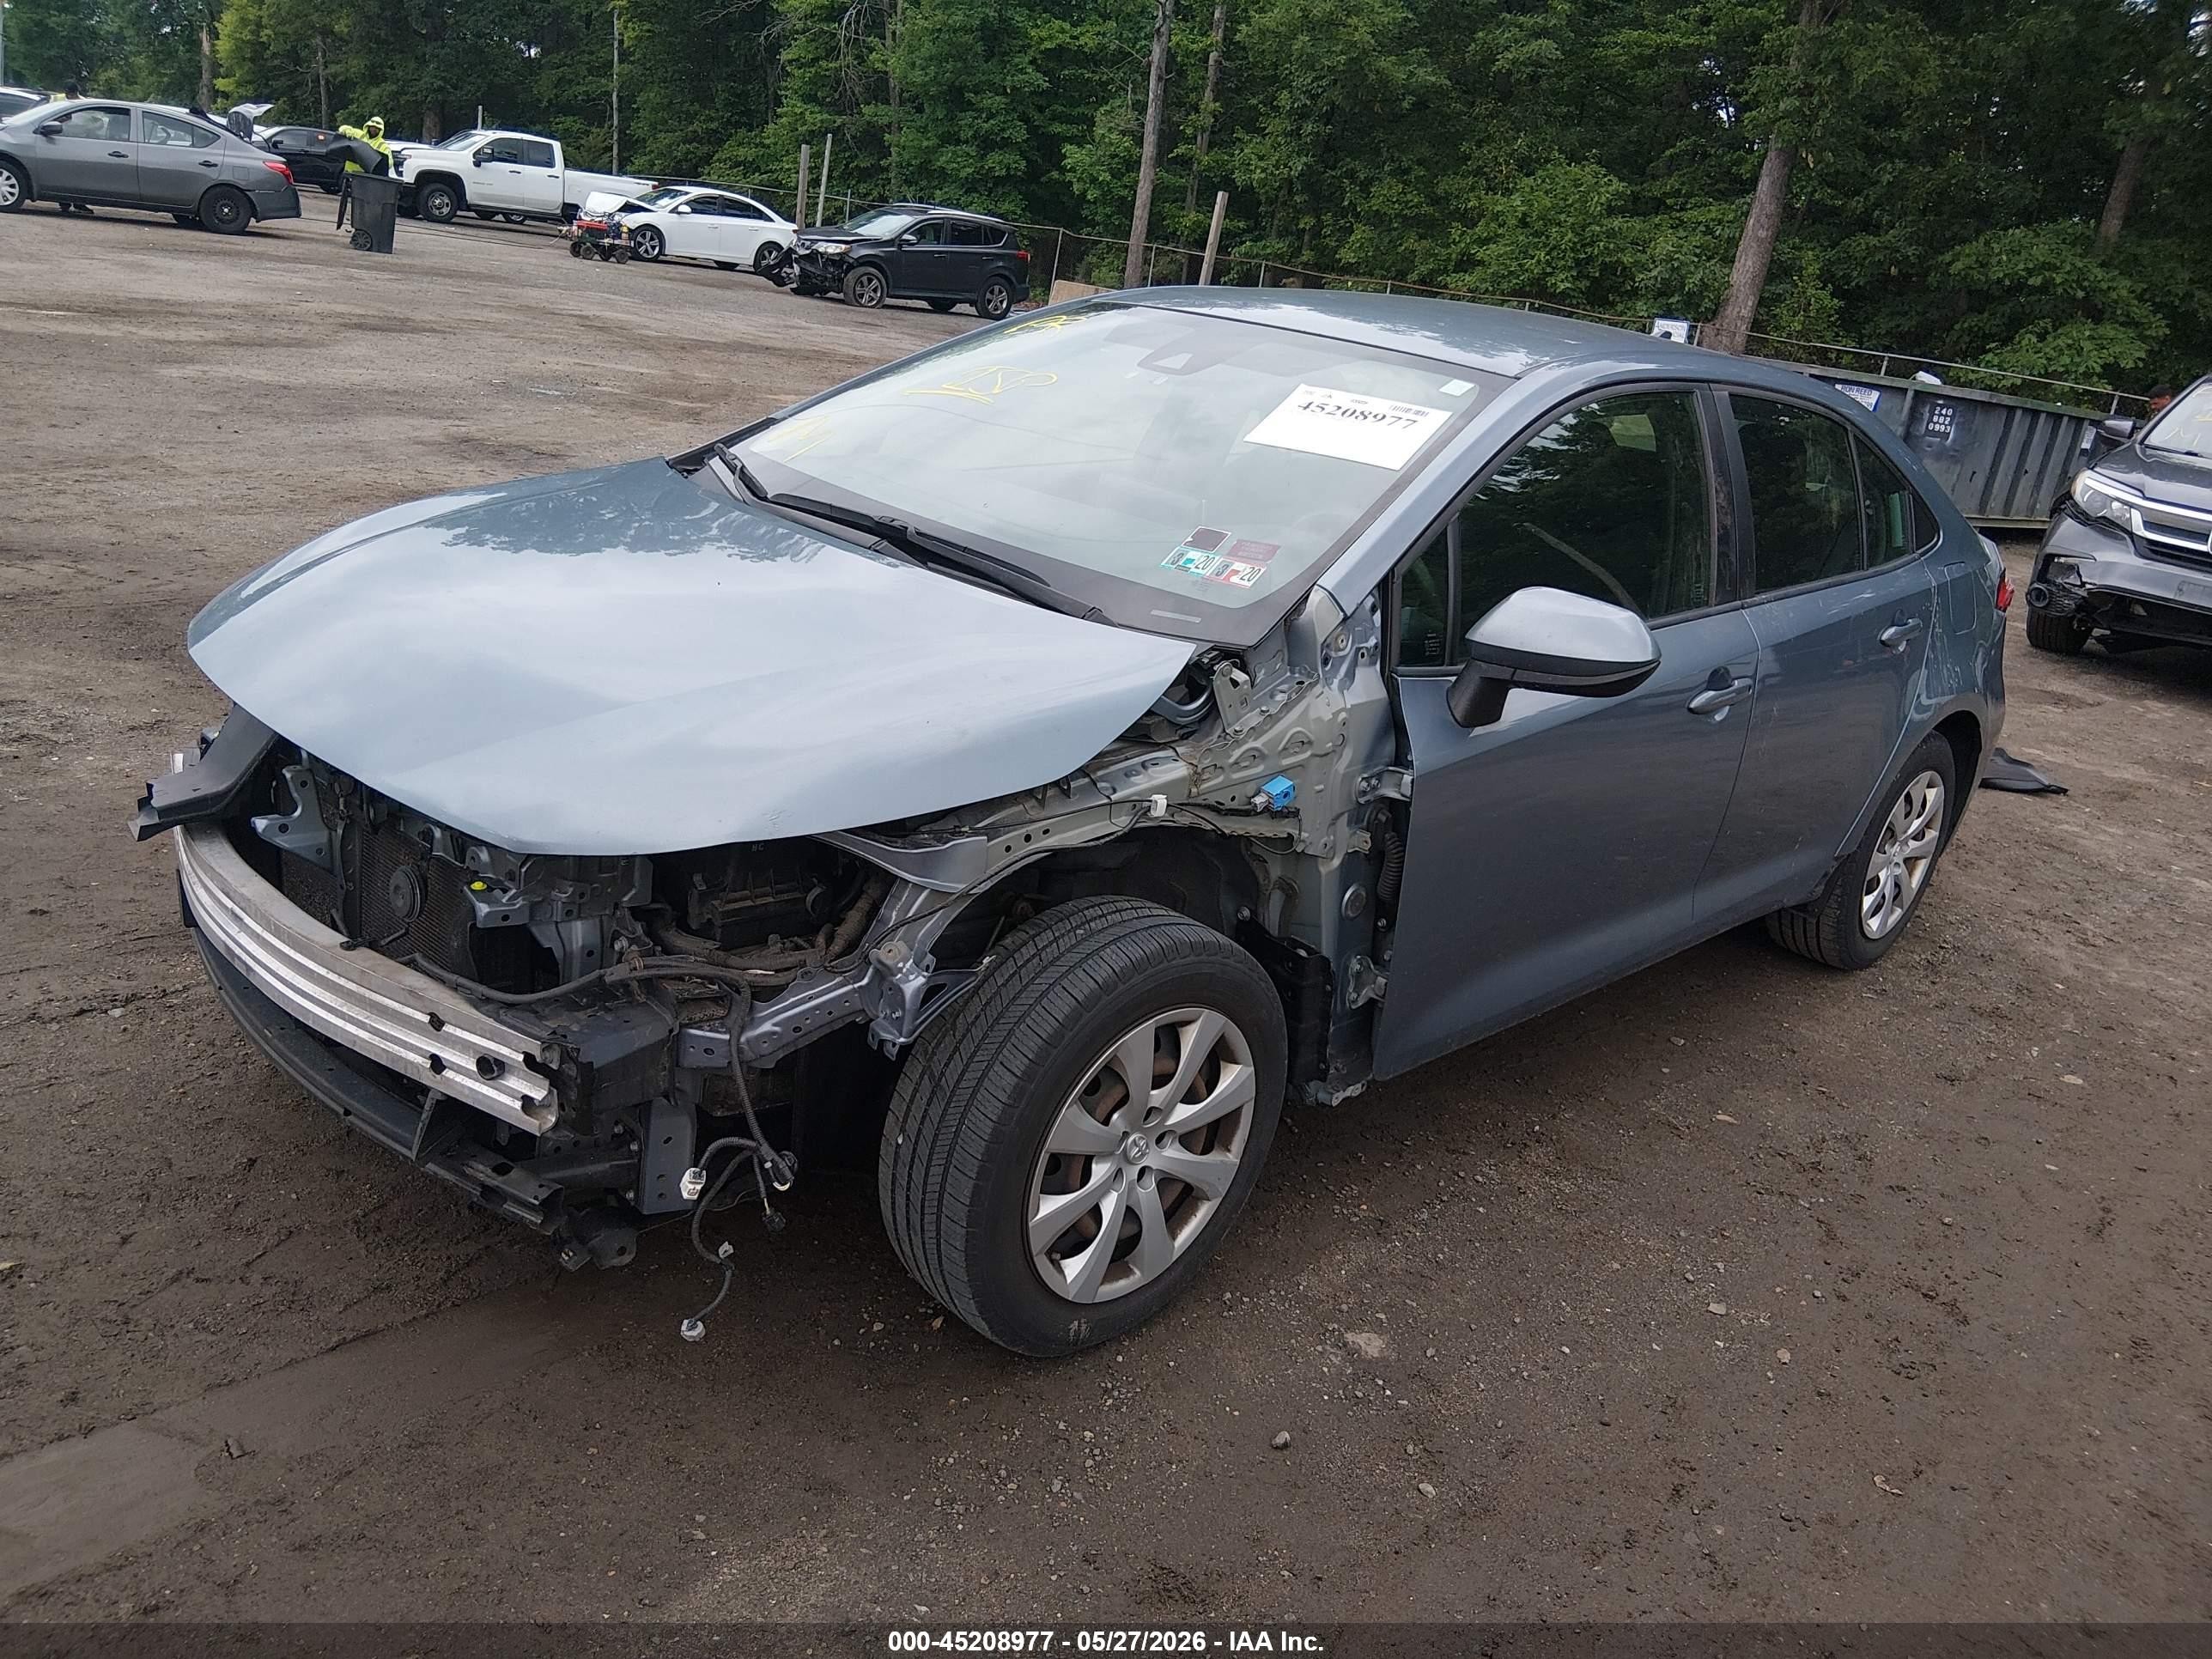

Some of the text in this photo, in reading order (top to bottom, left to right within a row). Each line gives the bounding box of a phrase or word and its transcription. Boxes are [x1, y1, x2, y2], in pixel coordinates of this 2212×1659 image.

[1297, 400, 1419, 429] 45208977
[1935, 406, 1953, 416] 240
[1928, 422, 1951, 433] 0993
[1194, 555, 1216, 570] 20
[1239, 566, 1262, 582] 20
